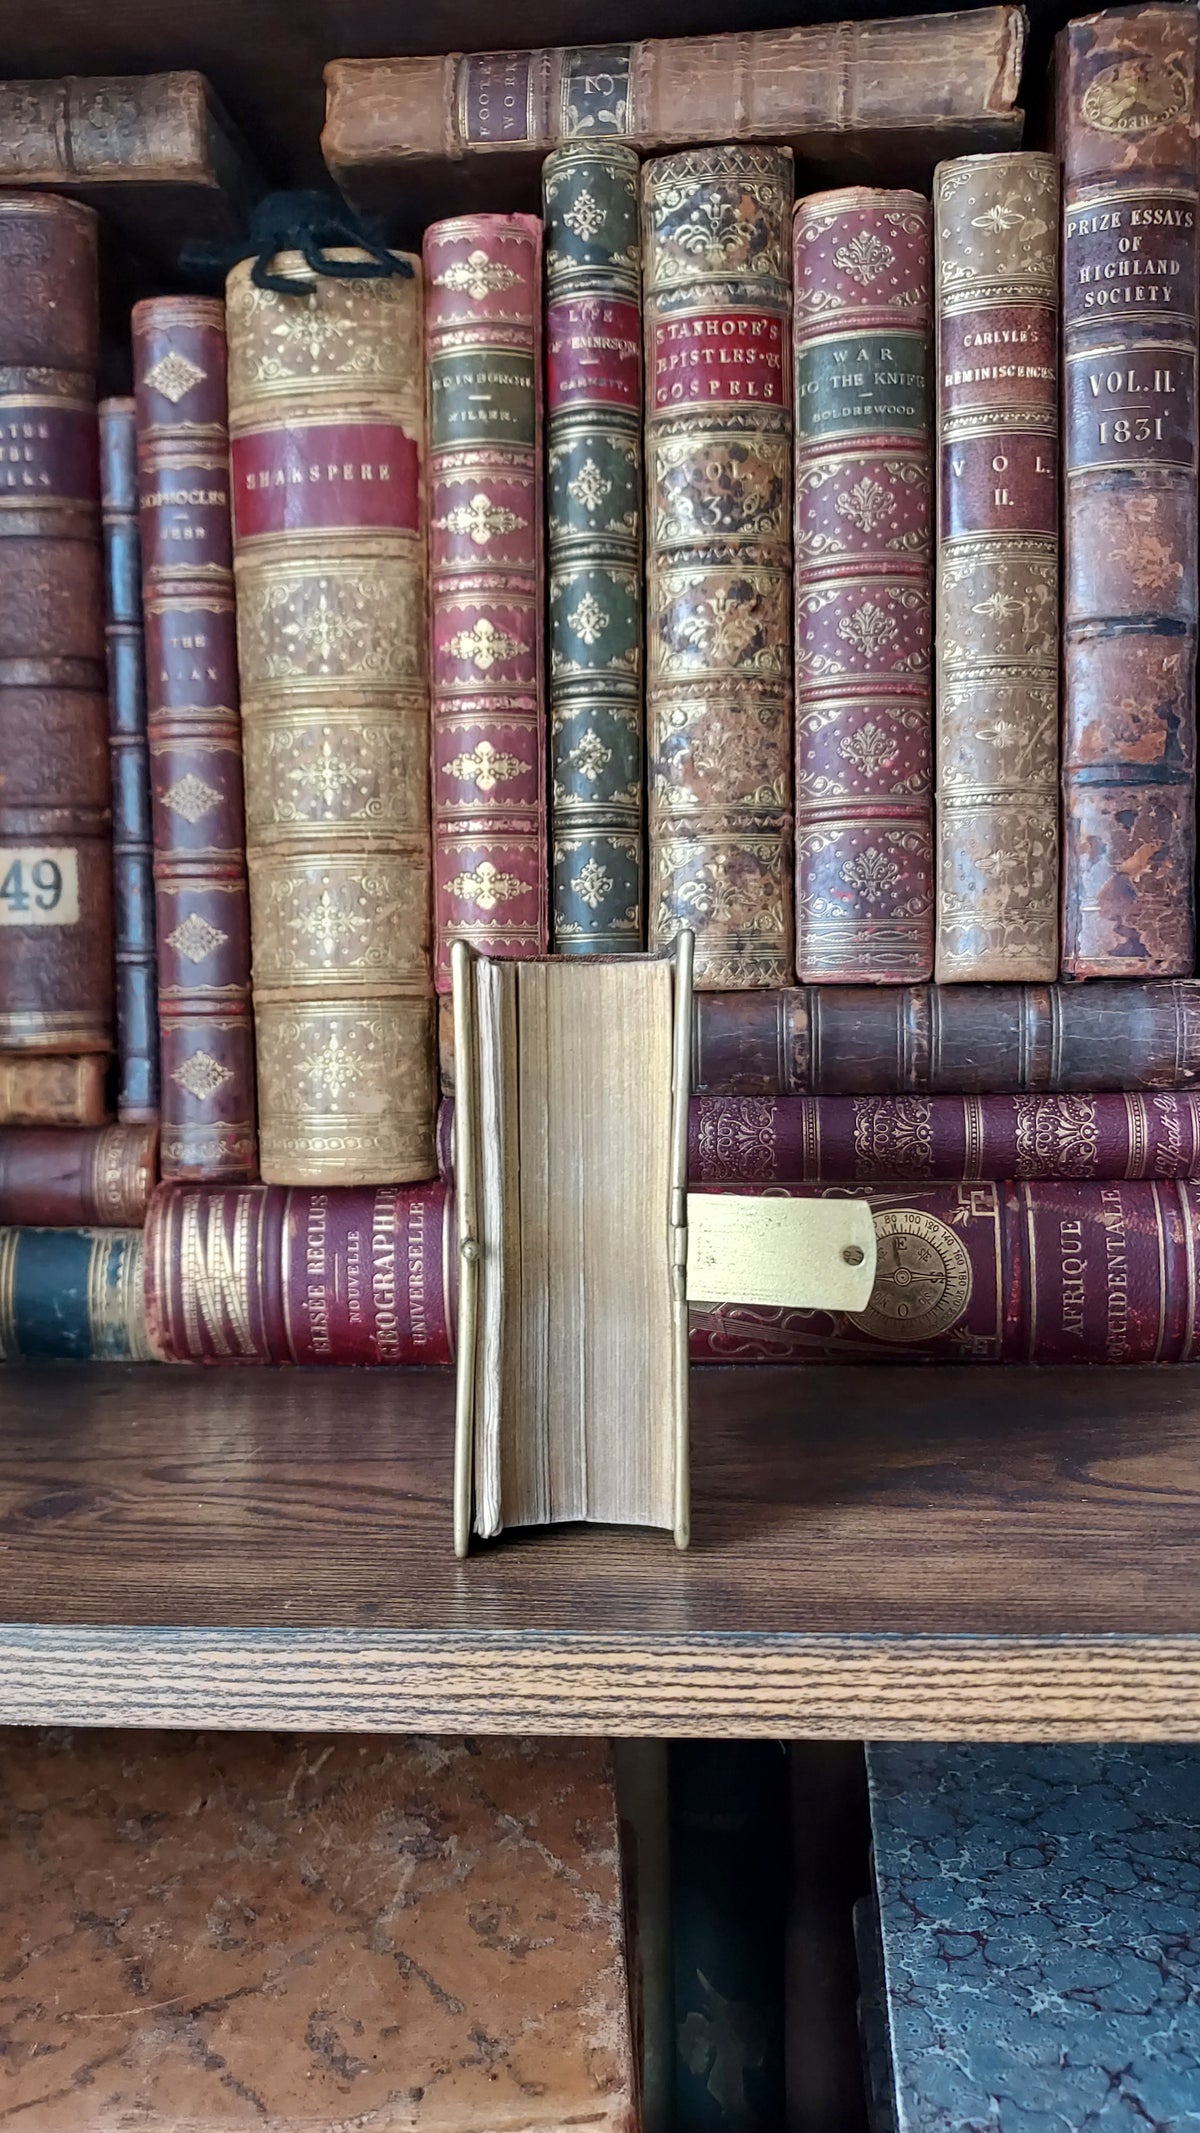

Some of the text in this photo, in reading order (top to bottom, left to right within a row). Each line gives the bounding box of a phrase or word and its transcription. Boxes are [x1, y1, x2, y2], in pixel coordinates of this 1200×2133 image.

[1067, 209, 1193, 239] PRIZE ESSAYS
[1118, 236, 1142, 253] OF
[1079, 259, 1181, 284] HIGHLAND
[1084, 285, 1172, 308] SOCIETY
[568, 308, 613, 323] LIFE
[656, 319, 779, 345] STANHOPE'S
[963, 325, 1039, 347] CARLYLE'S
[833, 348, 894, 363] WAR
[656, 380, 775, 402] GOSPELS
[800, 372, 925, 397] TO THE KNIFE
[812, 404, 915, 423] BOLDREWOOD
[1099, 418, 1163, 444] 1831
[246, 464, 390, 490] SHAKSPERE
[993, 488, 1015, 506] II.
[170, 634, 206, 649] THE
[0, 858, 63, 911] 49
[884, 1214, 897, 1225] 80
[904, 1214, 921, 1225] 100
[925, 1220, 940, 1233] 120
[306, 1194, 328, 1275] RECLUS
[942, 1231, 955, 1247] 140
[953, 1250, 965, 1266] 160
[347, 1231, 362, 1324] NOUVELLE
[369, 1188, 400, 1358] GÉOGRAPHIE
[407, 1202, 426, 1346] UNIVERSELLE
[958, 1270, 967, 1287] 180
[1060, 1220, 1087, 1338] AFRIQUE
